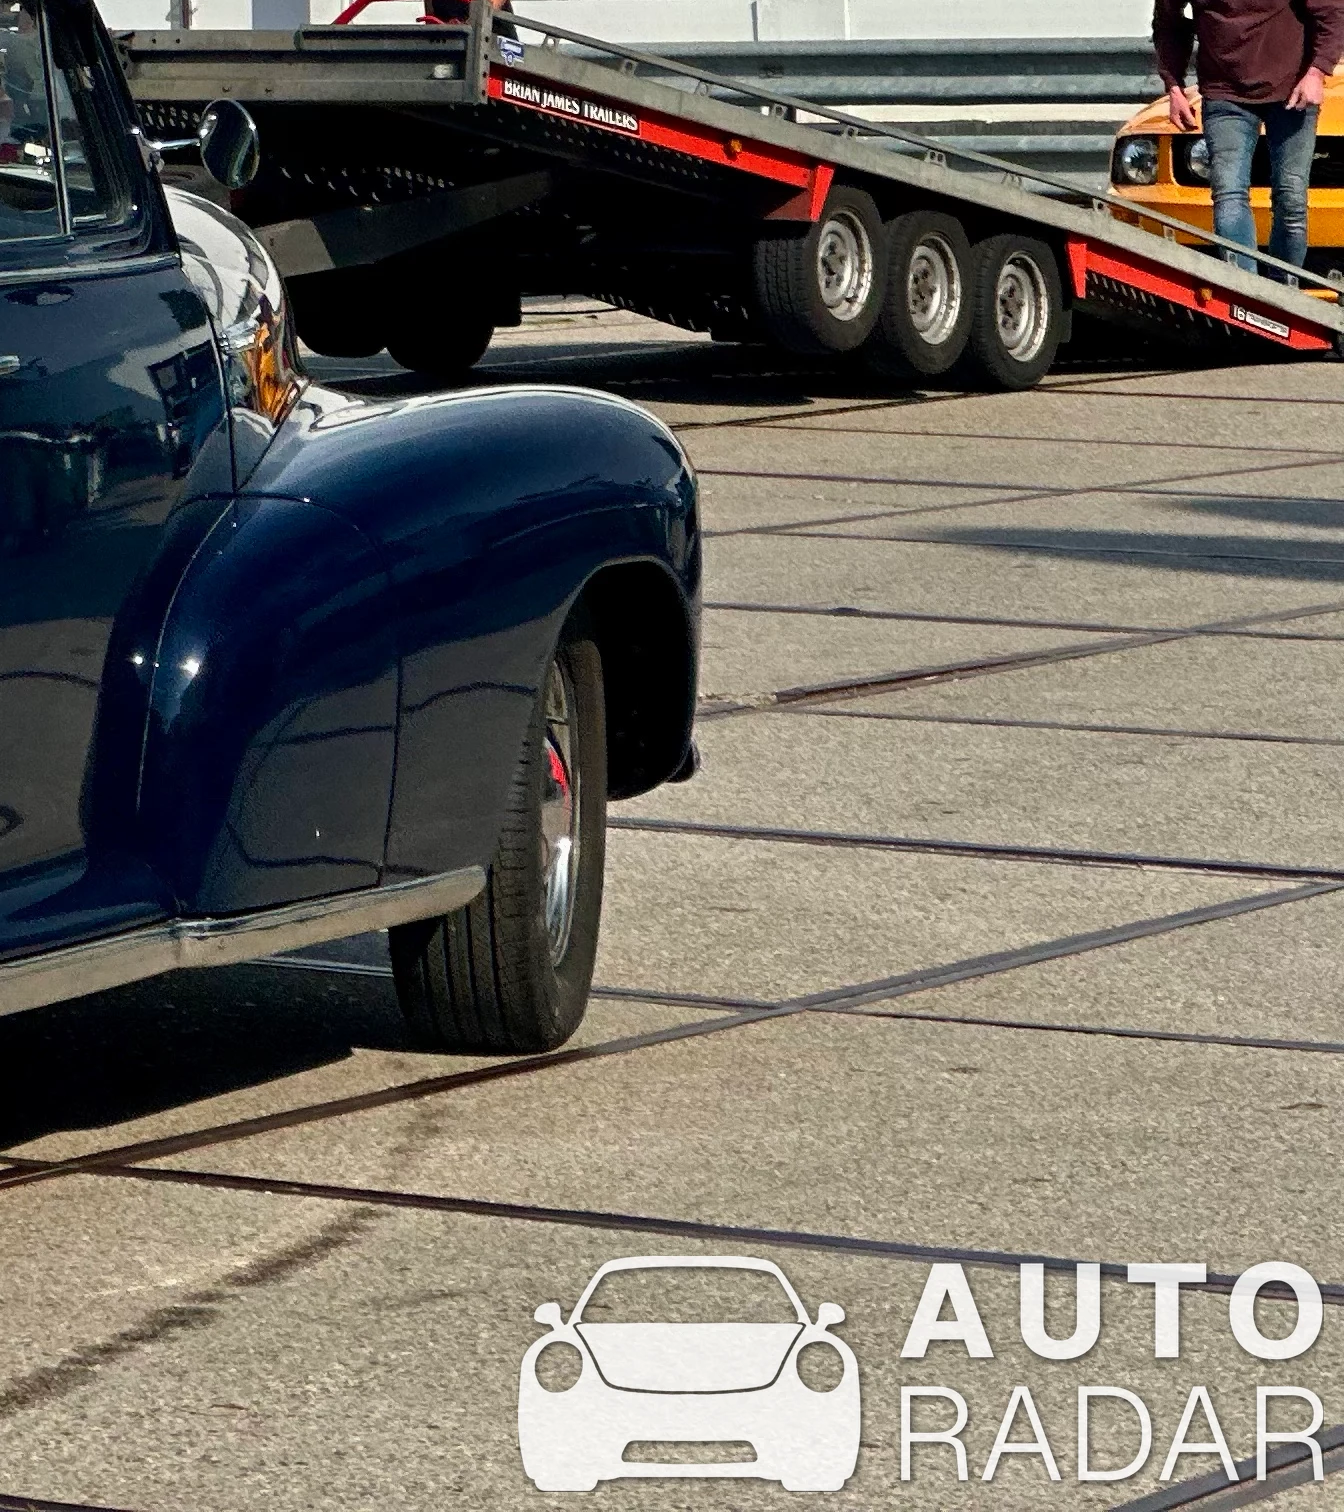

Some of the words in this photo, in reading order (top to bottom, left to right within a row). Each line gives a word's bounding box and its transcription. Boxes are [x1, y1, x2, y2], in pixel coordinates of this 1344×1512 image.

[504, 78, 541, 103] BRIAN
[541, 89, 580, 115] JAMES
[582, 101, 639, 131] TRAILERS
